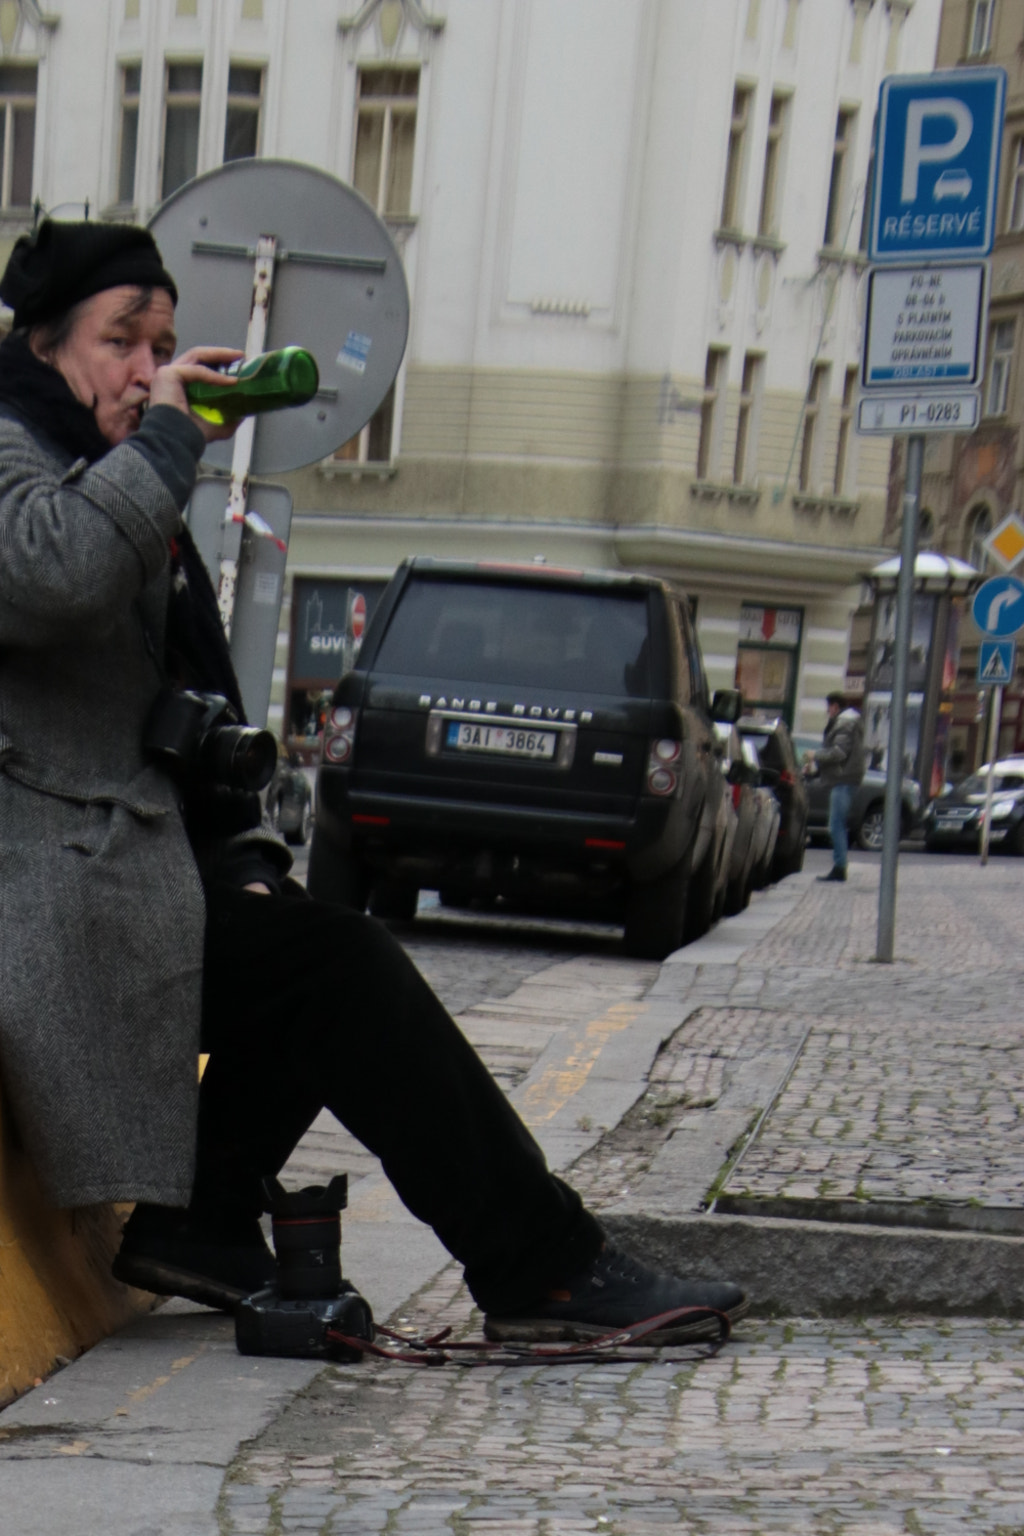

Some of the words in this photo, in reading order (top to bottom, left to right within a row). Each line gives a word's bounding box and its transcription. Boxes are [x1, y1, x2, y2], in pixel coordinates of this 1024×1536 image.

[900, 96, 974, 205] P
[883, 207, 981, 239] RÉSERVÉ
[900, 403, 961, 422] P1-0283
[419, 694, 497, 714] RANGE
[512, 703, 593, 724] ROVER
[505, 731, 547, 753] 3864
